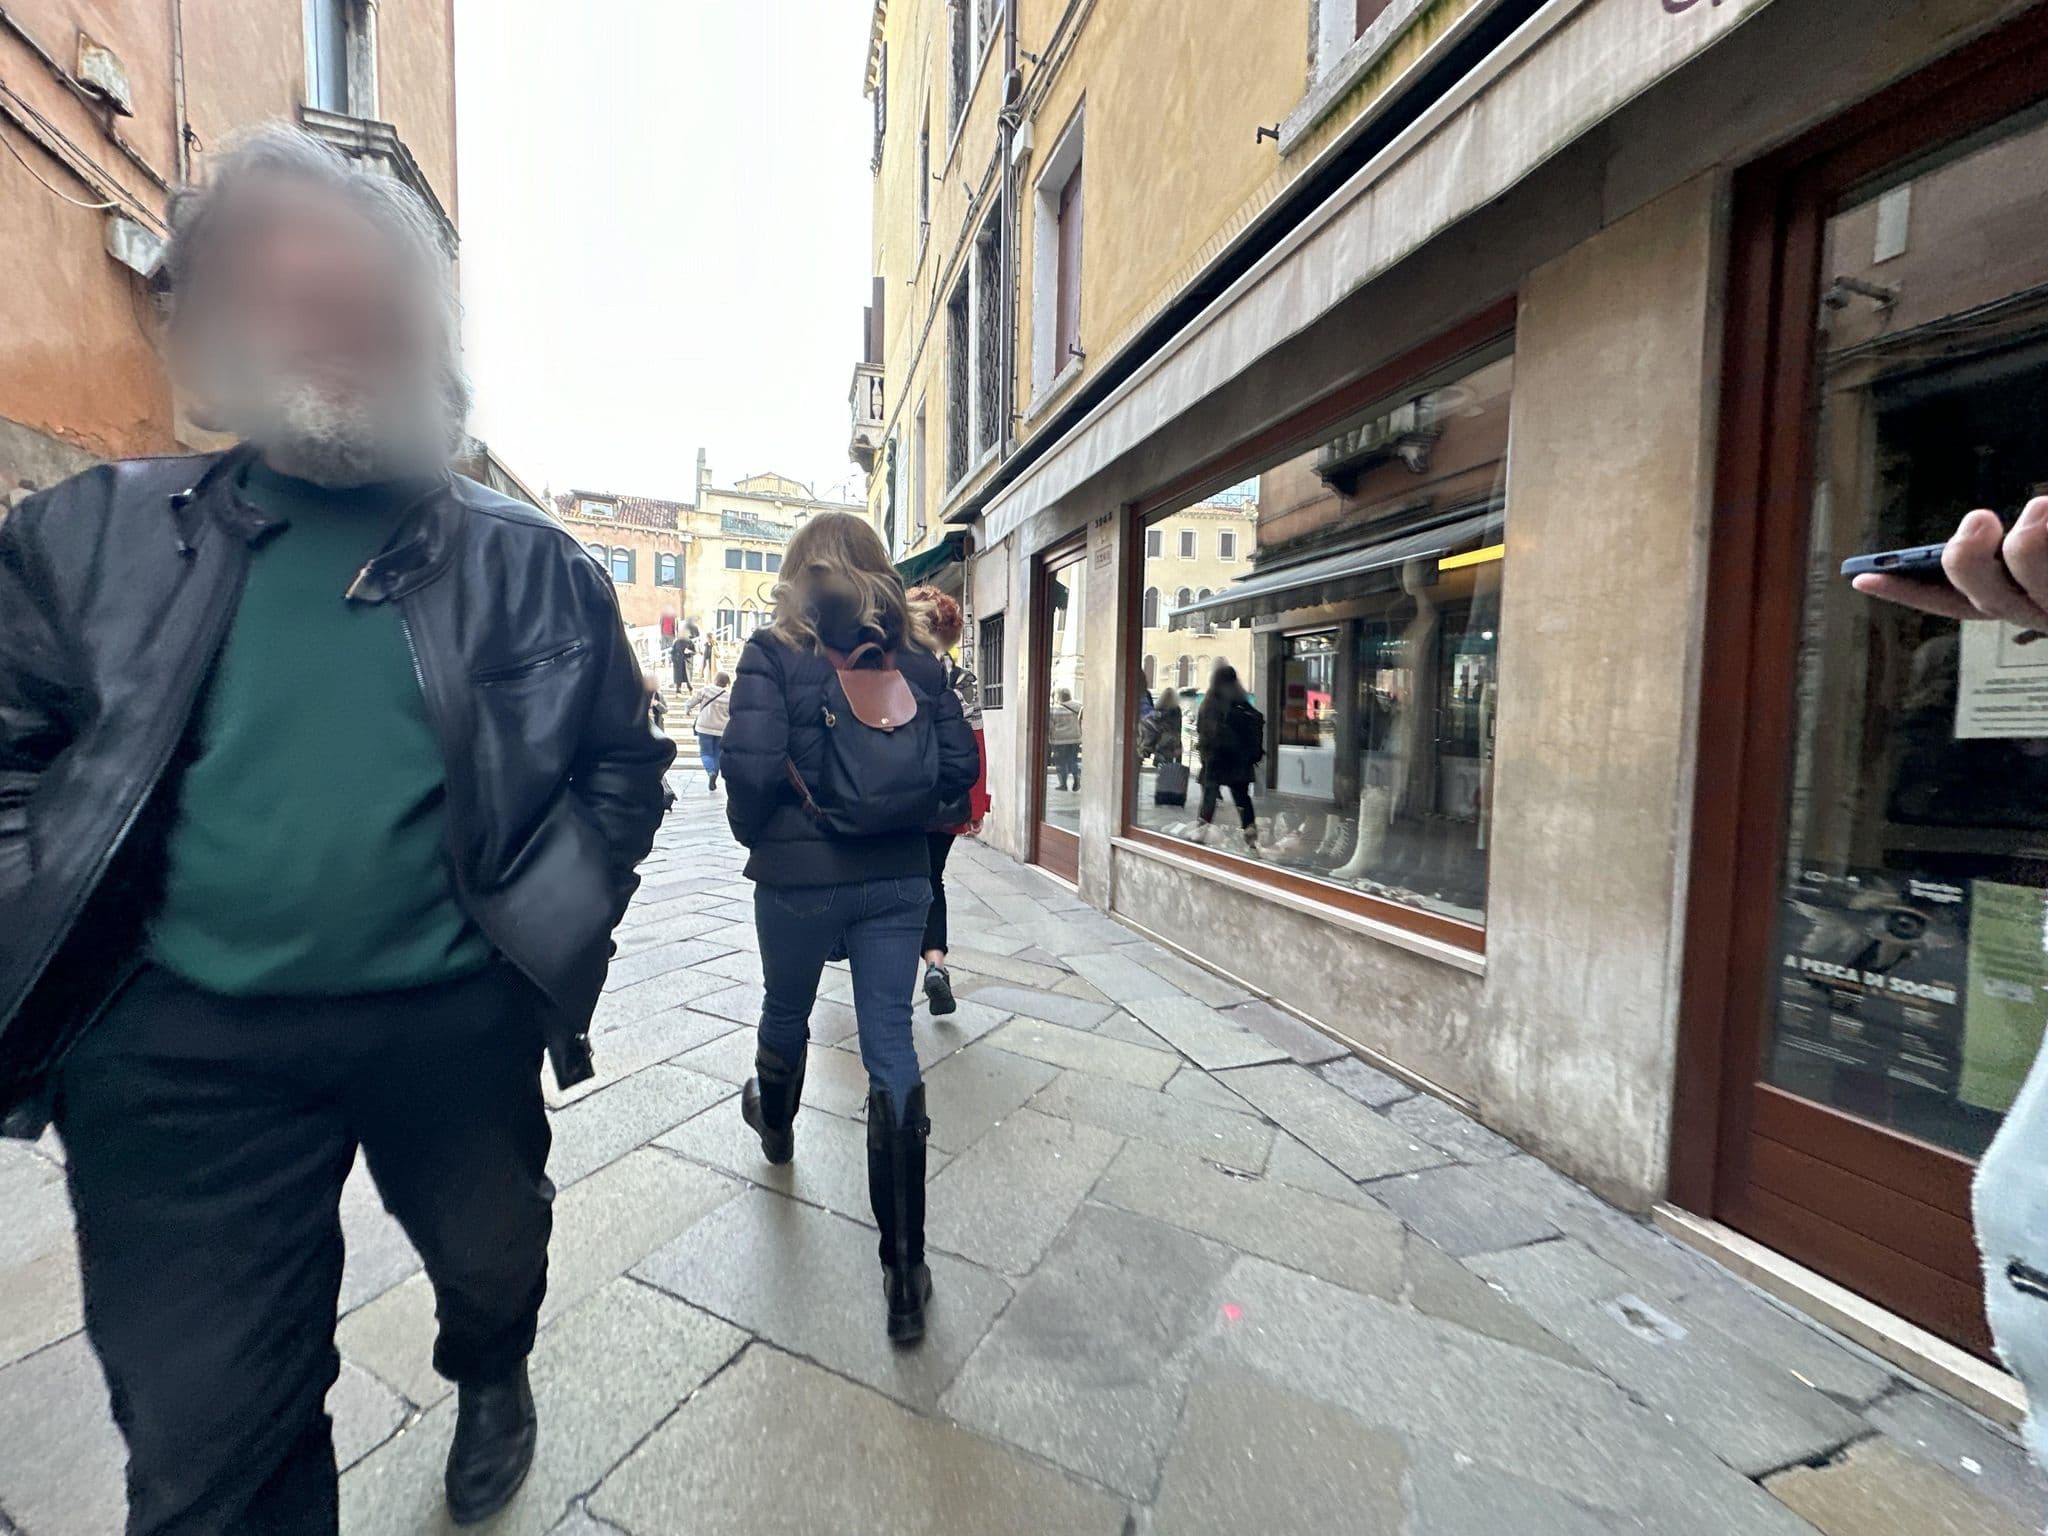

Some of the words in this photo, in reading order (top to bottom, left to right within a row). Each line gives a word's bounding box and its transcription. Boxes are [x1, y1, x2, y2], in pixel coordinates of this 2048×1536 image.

[1784, 954, 1798, 969] A
[1801, 957, 1859, 982] PESCA
[1863, 970, 1885, 988] DI
